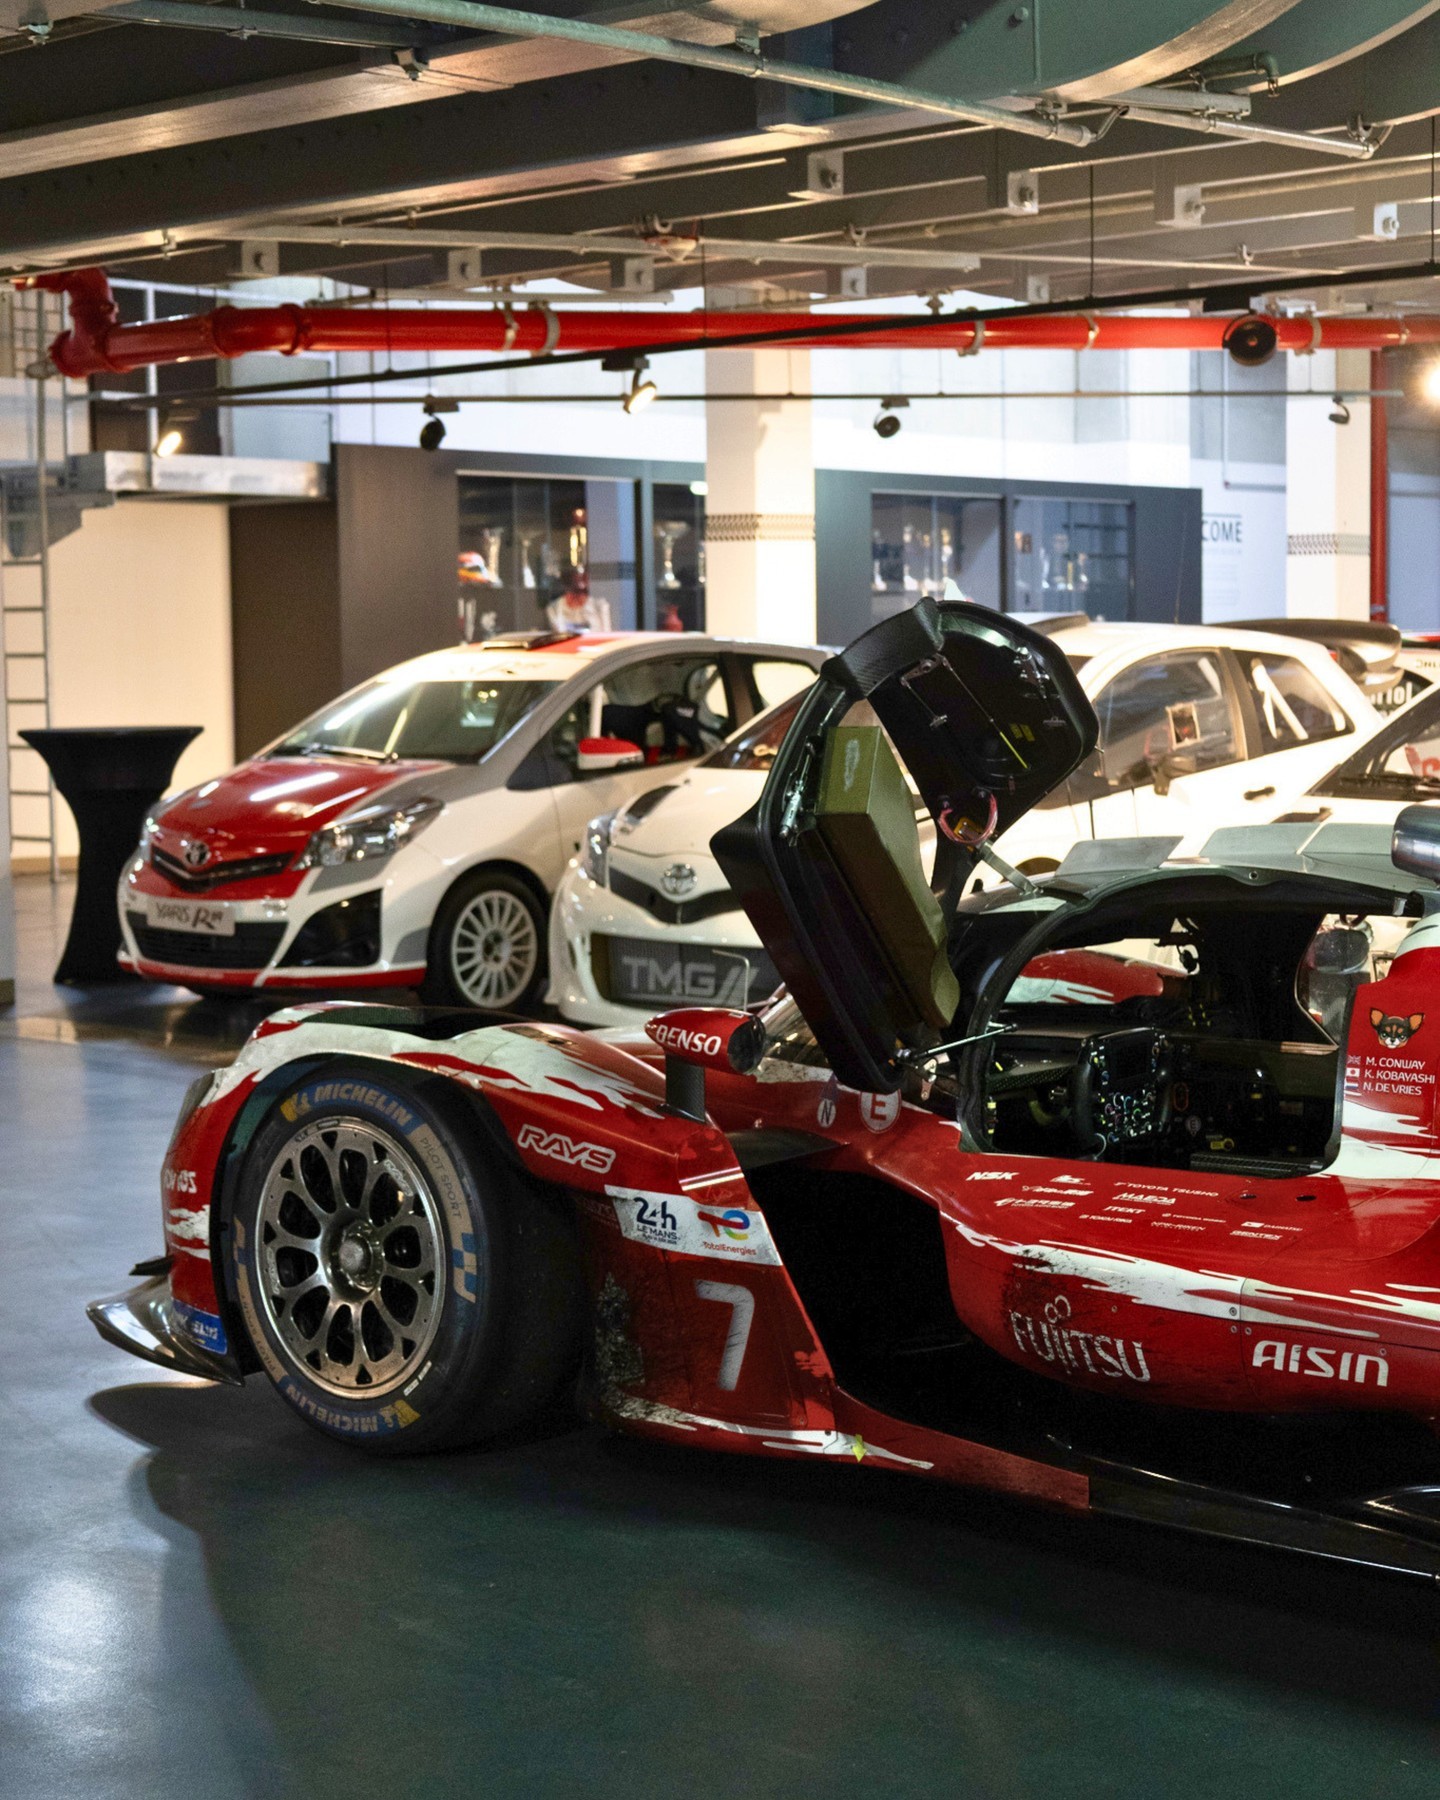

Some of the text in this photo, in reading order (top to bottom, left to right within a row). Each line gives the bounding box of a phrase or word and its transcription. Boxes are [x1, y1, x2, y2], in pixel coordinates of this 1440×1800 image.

[622, 956, 716, 997] TMG
[656, 1024, 722, 1056] DENSO
[1364, 1069, 1436, 1084] K. KOBAYASHI
[1365, 1056, 1426, 1070] M. CONWAY
[314, 1083, 414, 1127] MICHELIN
[1363, 1082, 1422, 1096] N. DE VRIES
[822, 1102, 833, 1125] N
[870, 1093, 887, 1121] E
[517, 1123, 616, 1174] RAYS
[421, 1137, 462, 1218] PILOT SPORT
[965, 1172, 1020, 1181] NSK
[637, 1224, 651, 1233] LE
[651, 1227, 679, 1240] MANS
[703, 1241, 757, 1256] TotalEnergies
[694, 1279, 755, 1391] 7
[1010, 1311, 1151, 1382] FUJITSU
[1252, 1340, 1389, 1387] AISIN
[285, 1383, 378, 1433] MICHELIN
